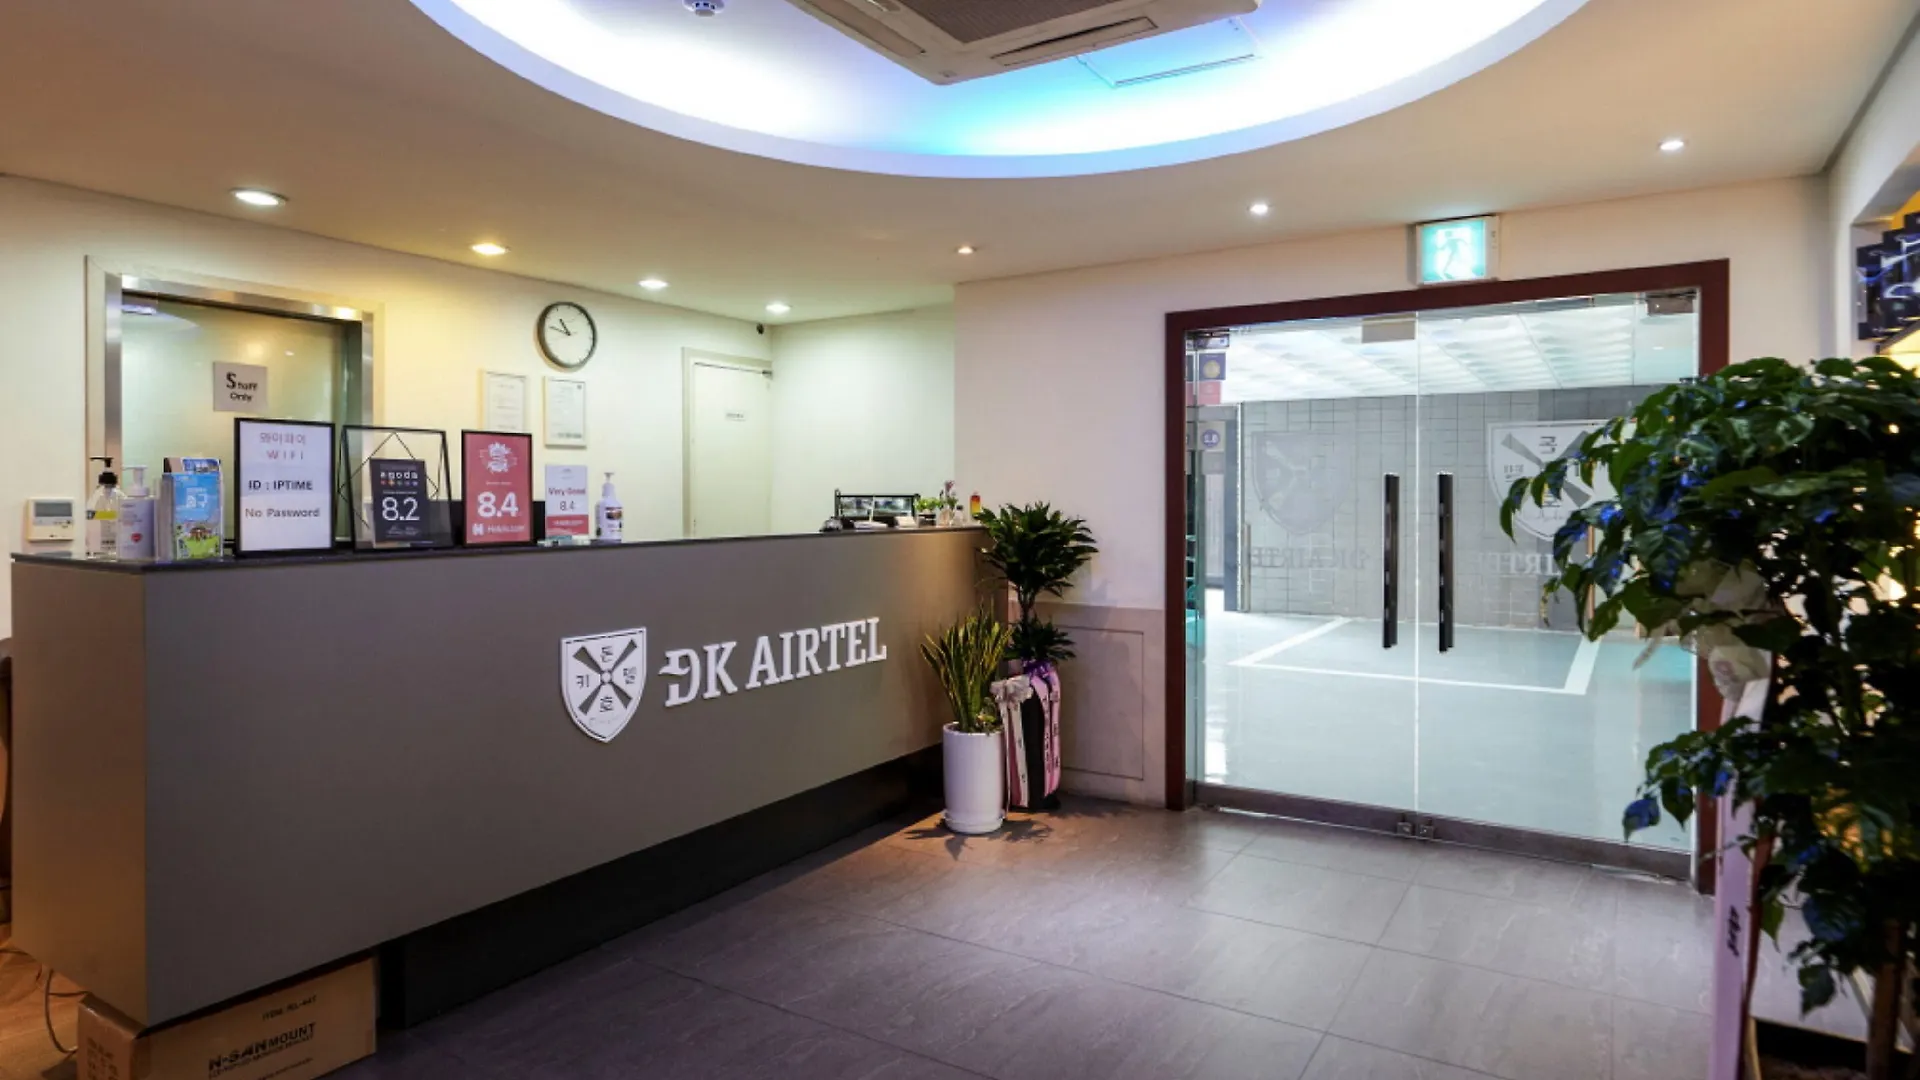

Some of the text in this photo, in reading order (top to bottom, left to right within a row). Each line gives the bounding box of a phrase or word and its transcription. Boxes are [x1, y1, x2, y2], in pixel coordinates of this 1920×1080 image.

[380, 469, 418, 481] agoda
[249, 479, 261, 491] ID
[273, 479, 313, 491] IPTIME
[245, 507, 321, 518] No Password
[381, 497, 420, 521] 8.2
[477, 491, 518, 518] 8.4
[659, 617, 887, 707] DK AIRTEL
